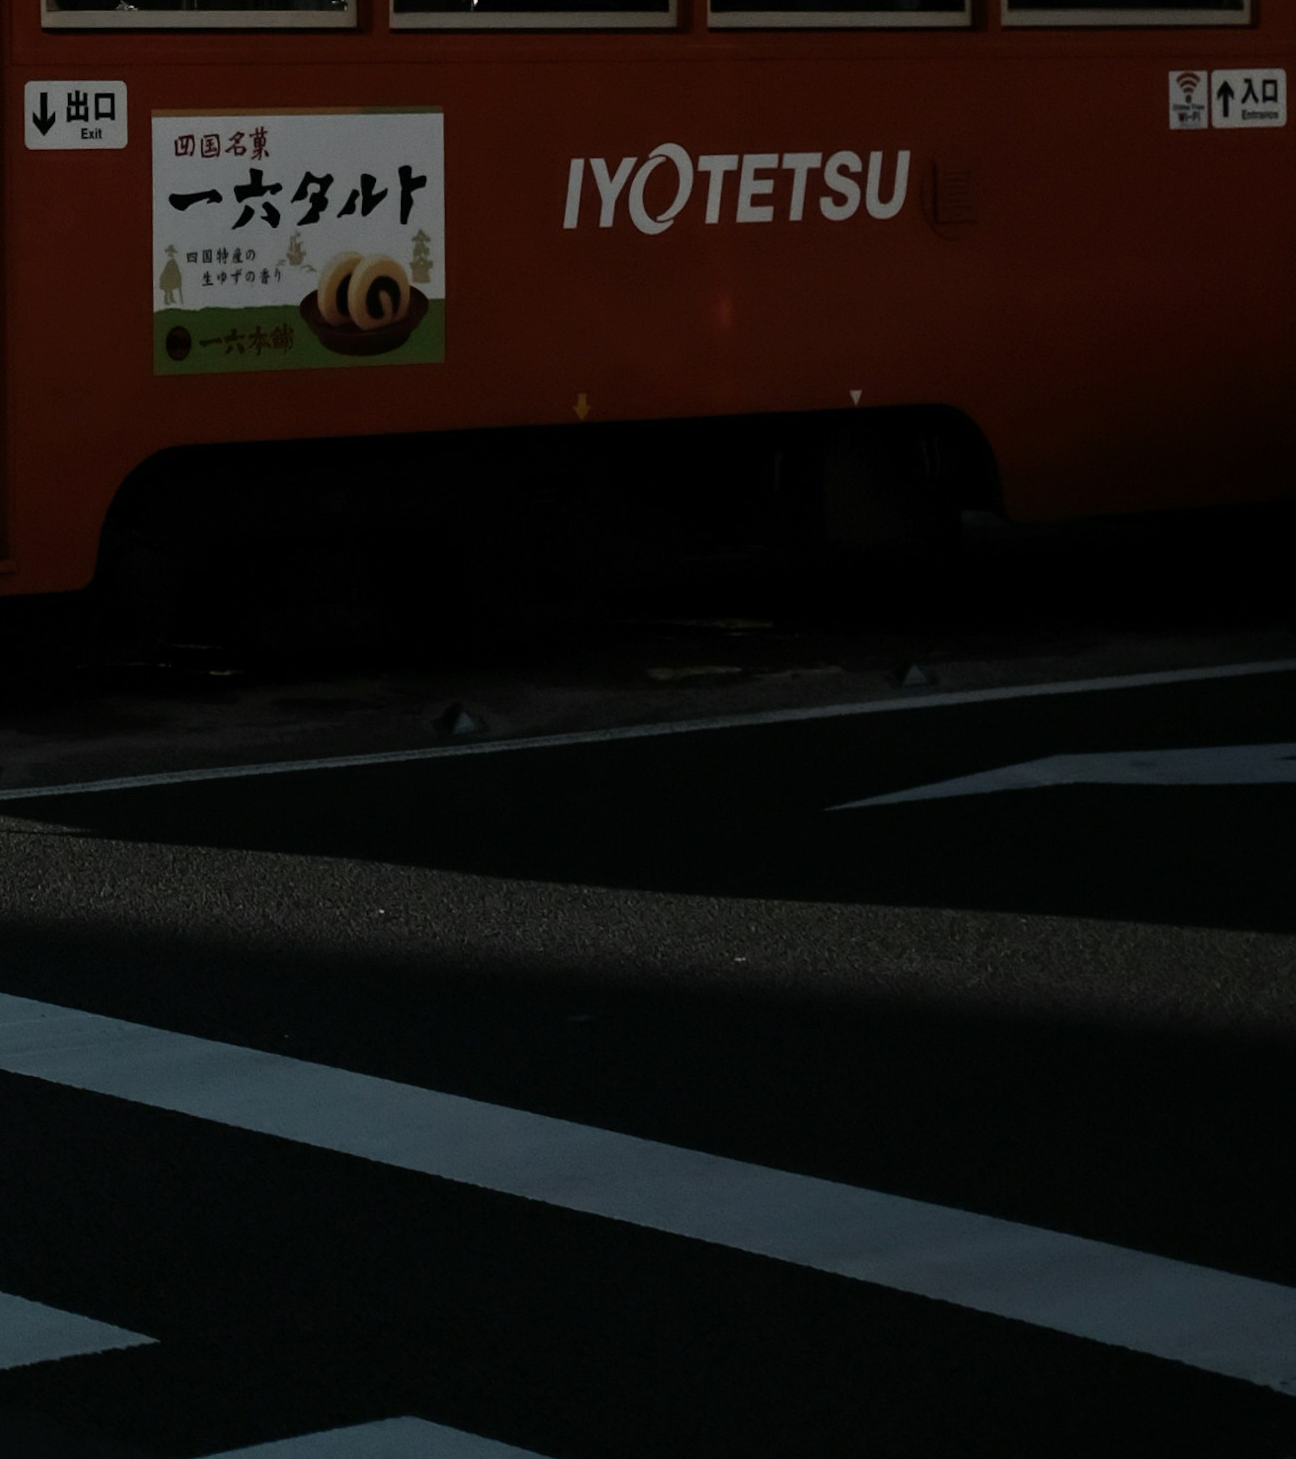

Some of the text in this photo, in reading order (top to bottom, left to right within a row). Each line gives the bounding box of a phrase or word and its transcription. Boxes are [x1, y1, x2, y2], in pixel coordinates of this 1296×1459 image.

[1242, 79, 1278, 104] 入口
[66, 90, 116, 123] 出口
[1242, 110, 1278, 121] Entrance
[80, 128, 103, 140] Exit
[173, 126, 271, 160] 四国名菓
[168, 164, 428, 230] 一六タルト
[562, 142, 911, 236] IYOTETSU
[186, 247, 256, 266] 四国特産の
[201, 267, 282, 287] 生ゆずの香り
